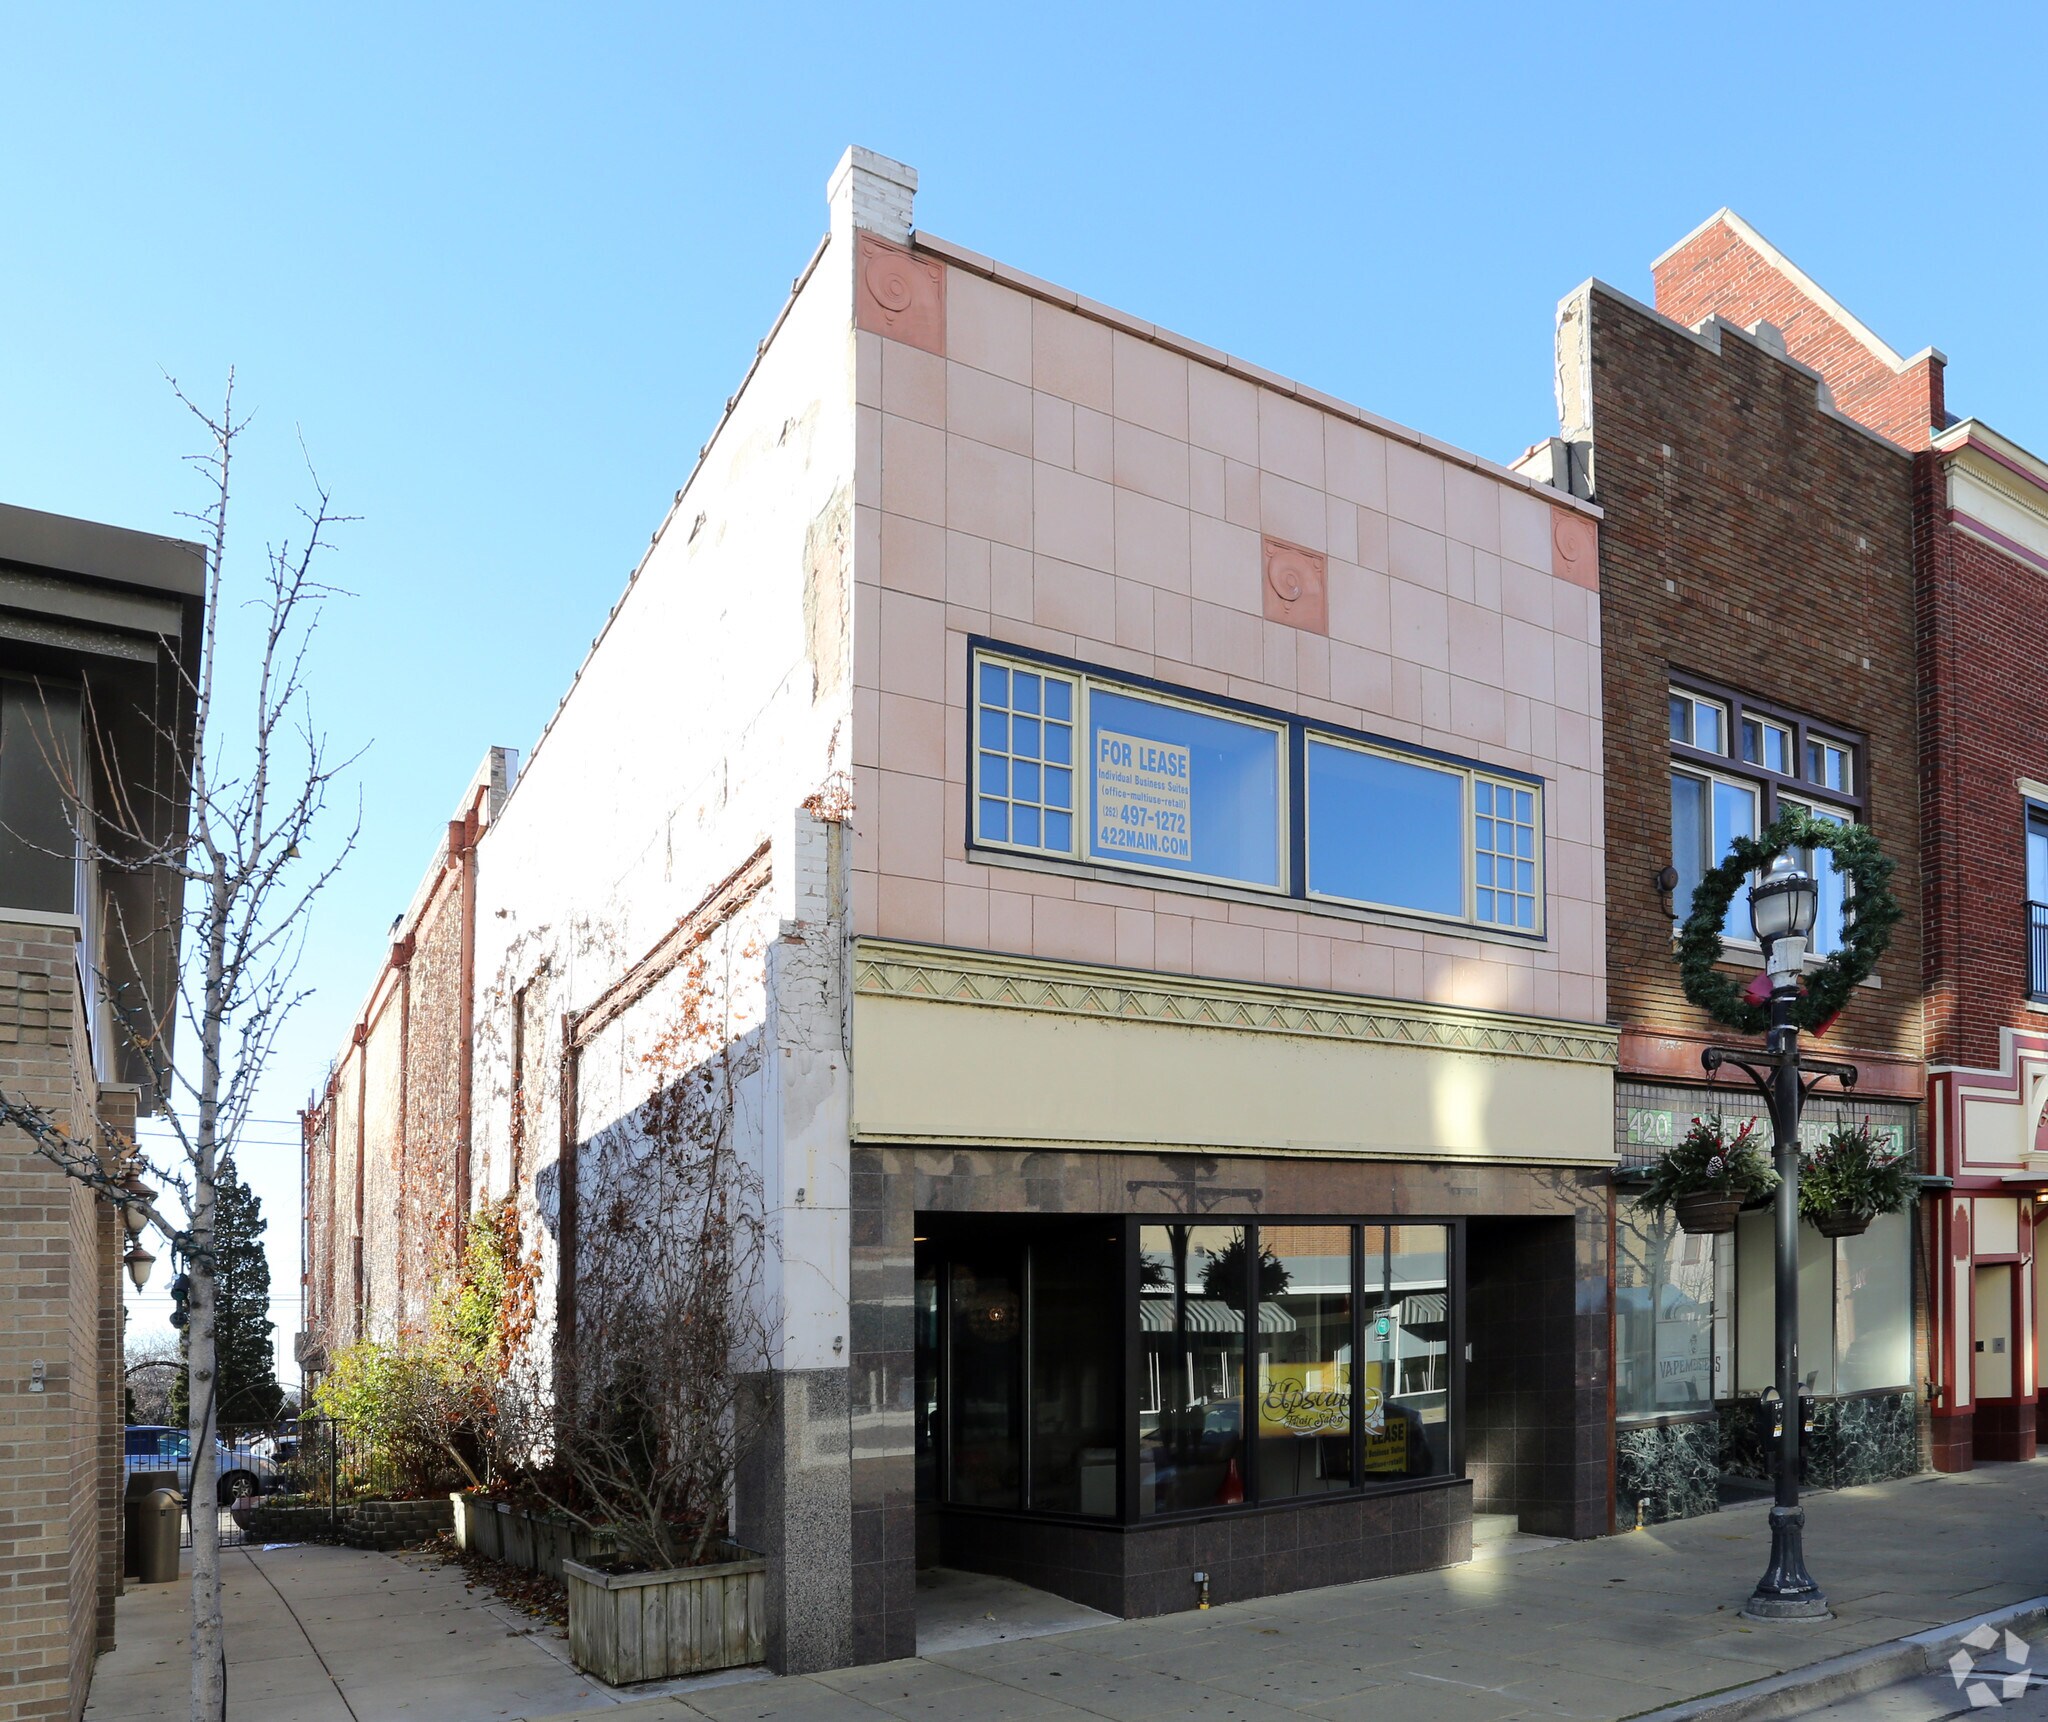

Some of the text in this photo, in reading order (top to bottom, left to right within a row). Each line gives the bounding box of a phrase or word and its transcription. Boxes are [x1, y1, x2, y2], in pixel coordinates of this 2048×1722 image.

[1101, 738, 1187, 778] FOR LEASE
[1099, 768, 1189, 795] Individual Business Suites
[1121, 804, 1185, 834] 497-1272
[1101, 826, 1188, 856] 422MAIN.COM
[1628, 1109, 1667, 1143] 420
[1659, 1355, 1721, 1378] VAPEMEISTES
